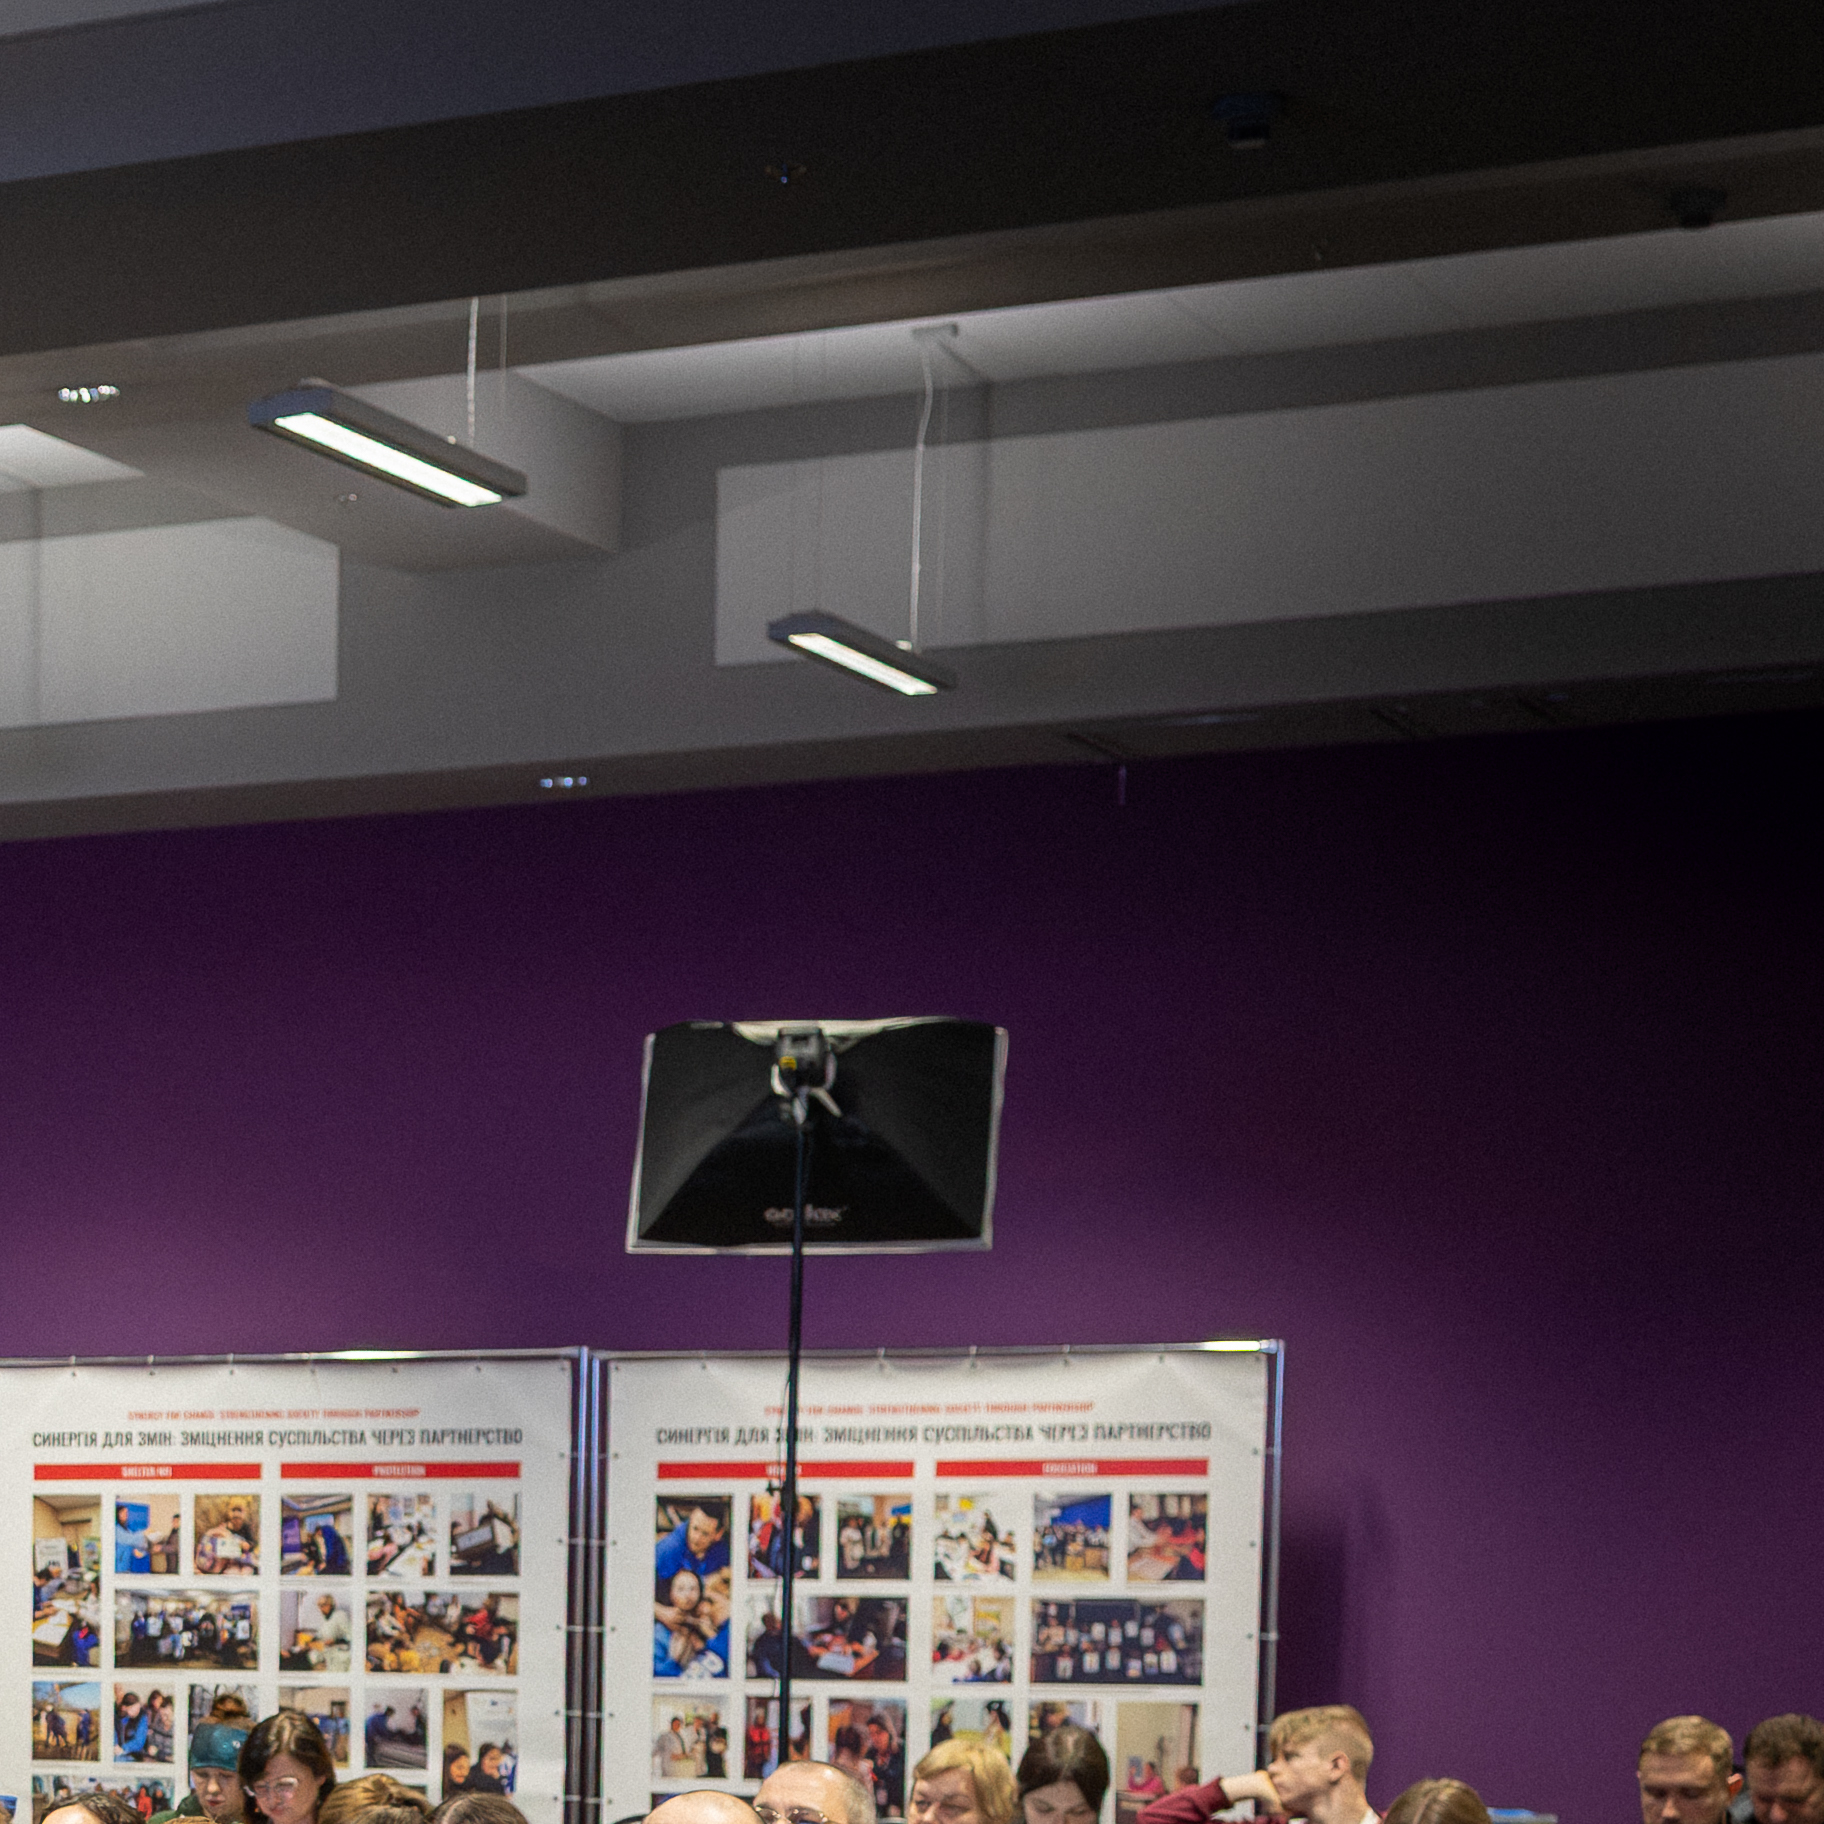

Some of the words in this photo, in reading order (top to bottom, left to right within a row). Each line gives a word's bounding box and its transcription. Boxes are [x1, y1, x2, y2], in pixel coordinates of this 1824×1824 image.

[33, 1431, 97, 1447] СИНЕРГІЯ
[102, 1430, 133, 1448] ДЛЯ
[181, 1430, 263, 1448] ЗМІЦНЕННЯ
[269, 1429, 367, 1447] СУСПІЛЬСТВА
[371, 1428, 415, 1446] ЧЕРЕЗ
[420, 1427, 523, 1445] ПАРТНЕРСТВО
[656, 1427, 729, 1445] СИНЕРГІЯ
[735, 1426, 769, 1446] ДЛЯ
[1039, 1422, 1088, 1442] ЧЕРЕЗ
[1093, 1420, 1211, 1442] ПАРТНЕРСТВО
